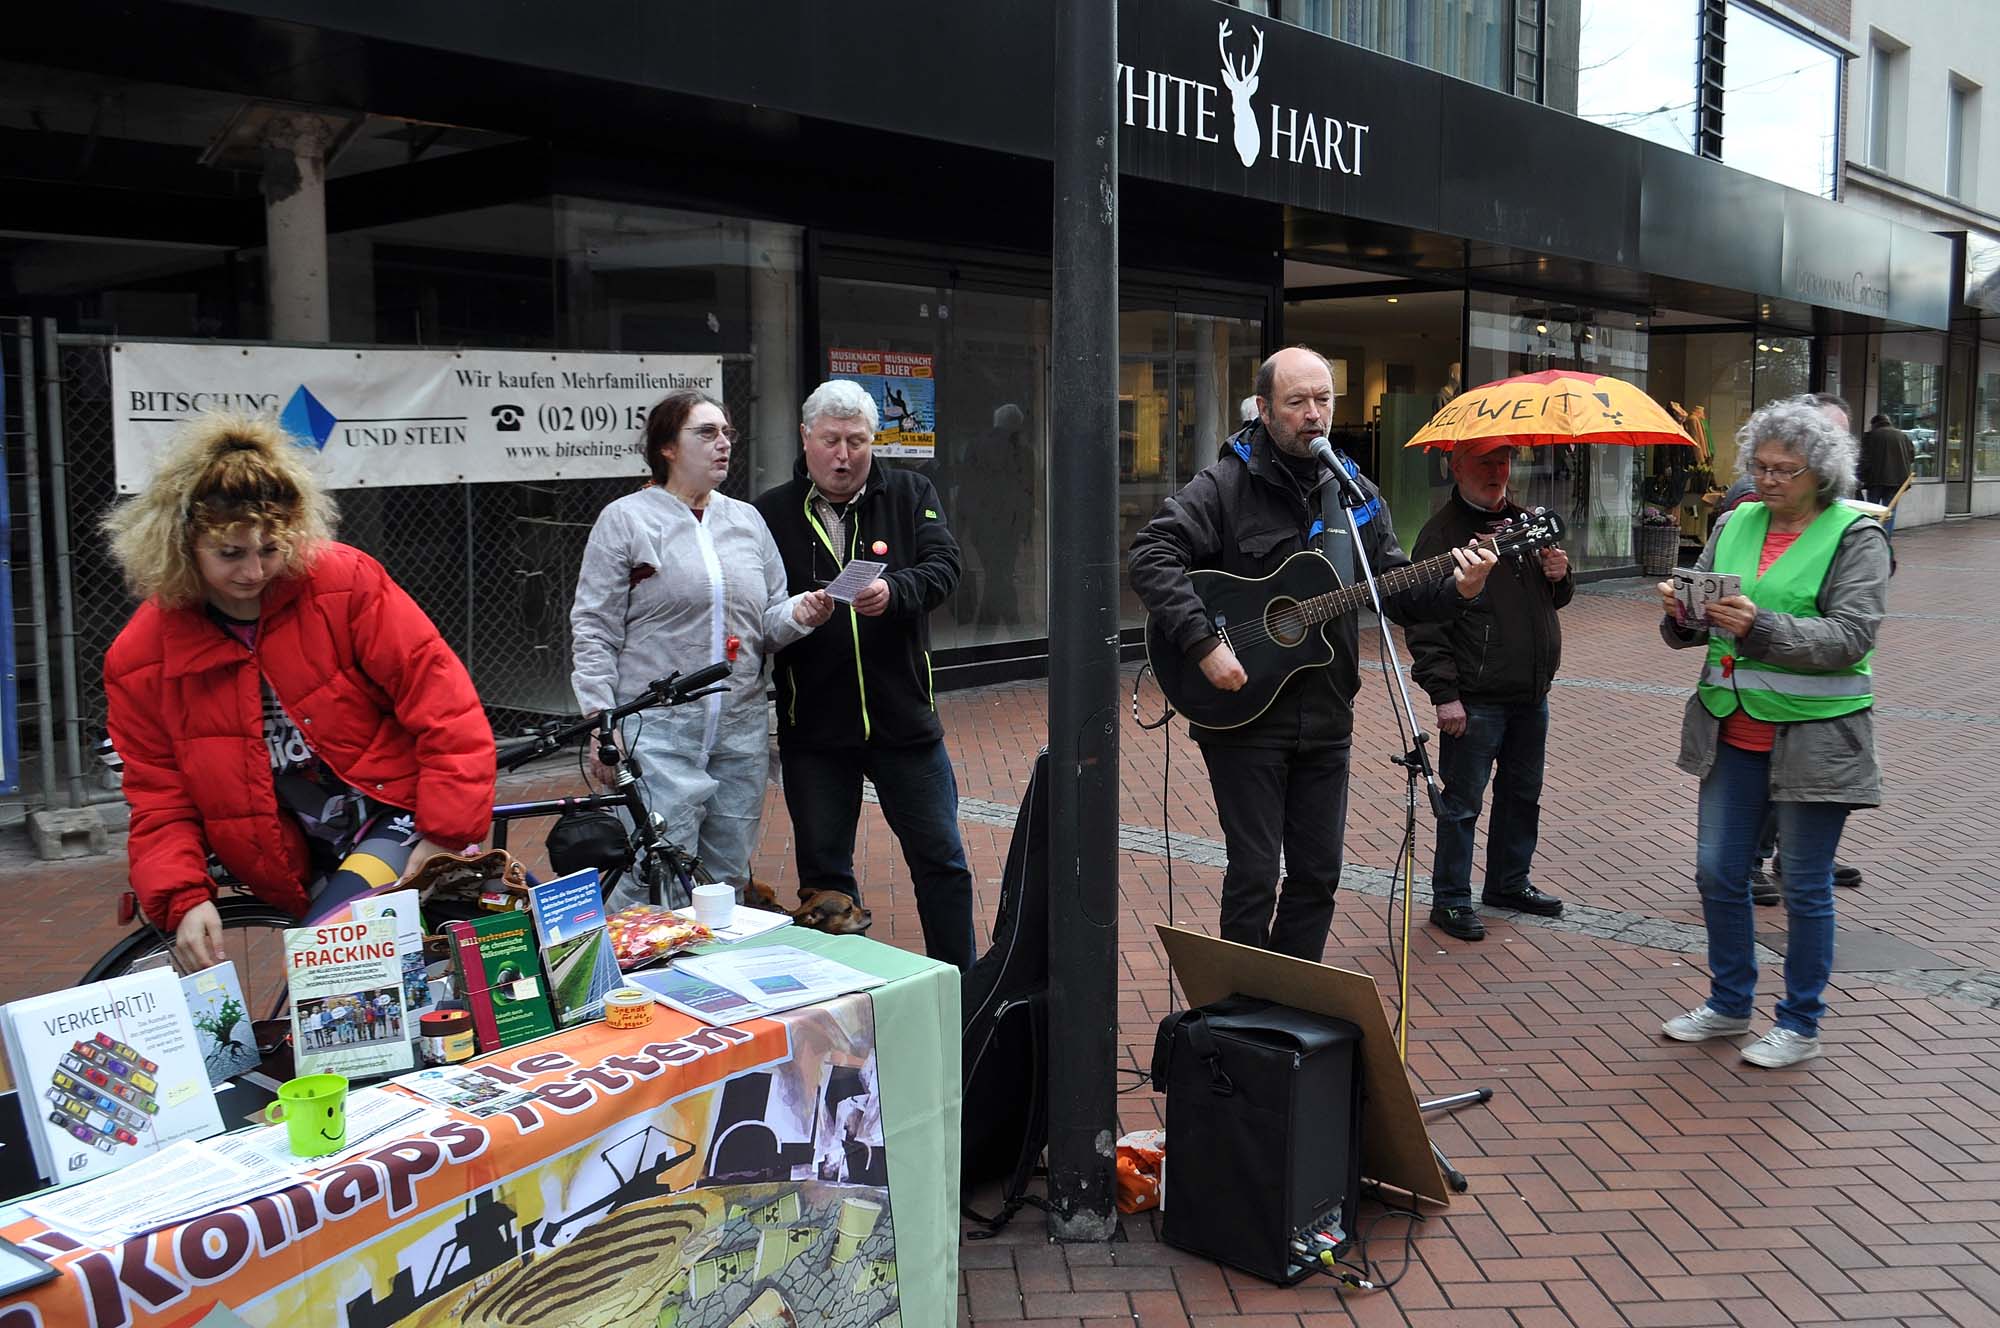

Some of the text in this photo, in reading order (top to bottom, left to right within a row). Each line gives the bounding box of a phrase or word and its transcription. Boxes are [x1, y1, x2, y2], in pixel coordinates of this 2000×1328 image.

[1117, 63, 1369, 176] HITE HART
[831, 351, 880, 361] MUSIKNACHT
[884, 354, 932, 365] MUSIKNACHT
[831, 361, 858, 373] BUER
[885, 364, 910, 376] BUER
[456, 370, 713, 389] Wir kaufen Mehrfamilienhäuser
[129, 391, 280, 412] BITSCHING
[538, 403, 575, 433] (02
[581, 403, 617, 433] 09)
[345, 425, 467, 447] UND STEIN
[316, 924, 367, 945] STOP
[294, 942, 395, 969] FRACKING
[44, 992, 157, 1037] VERKEHR[T]!
